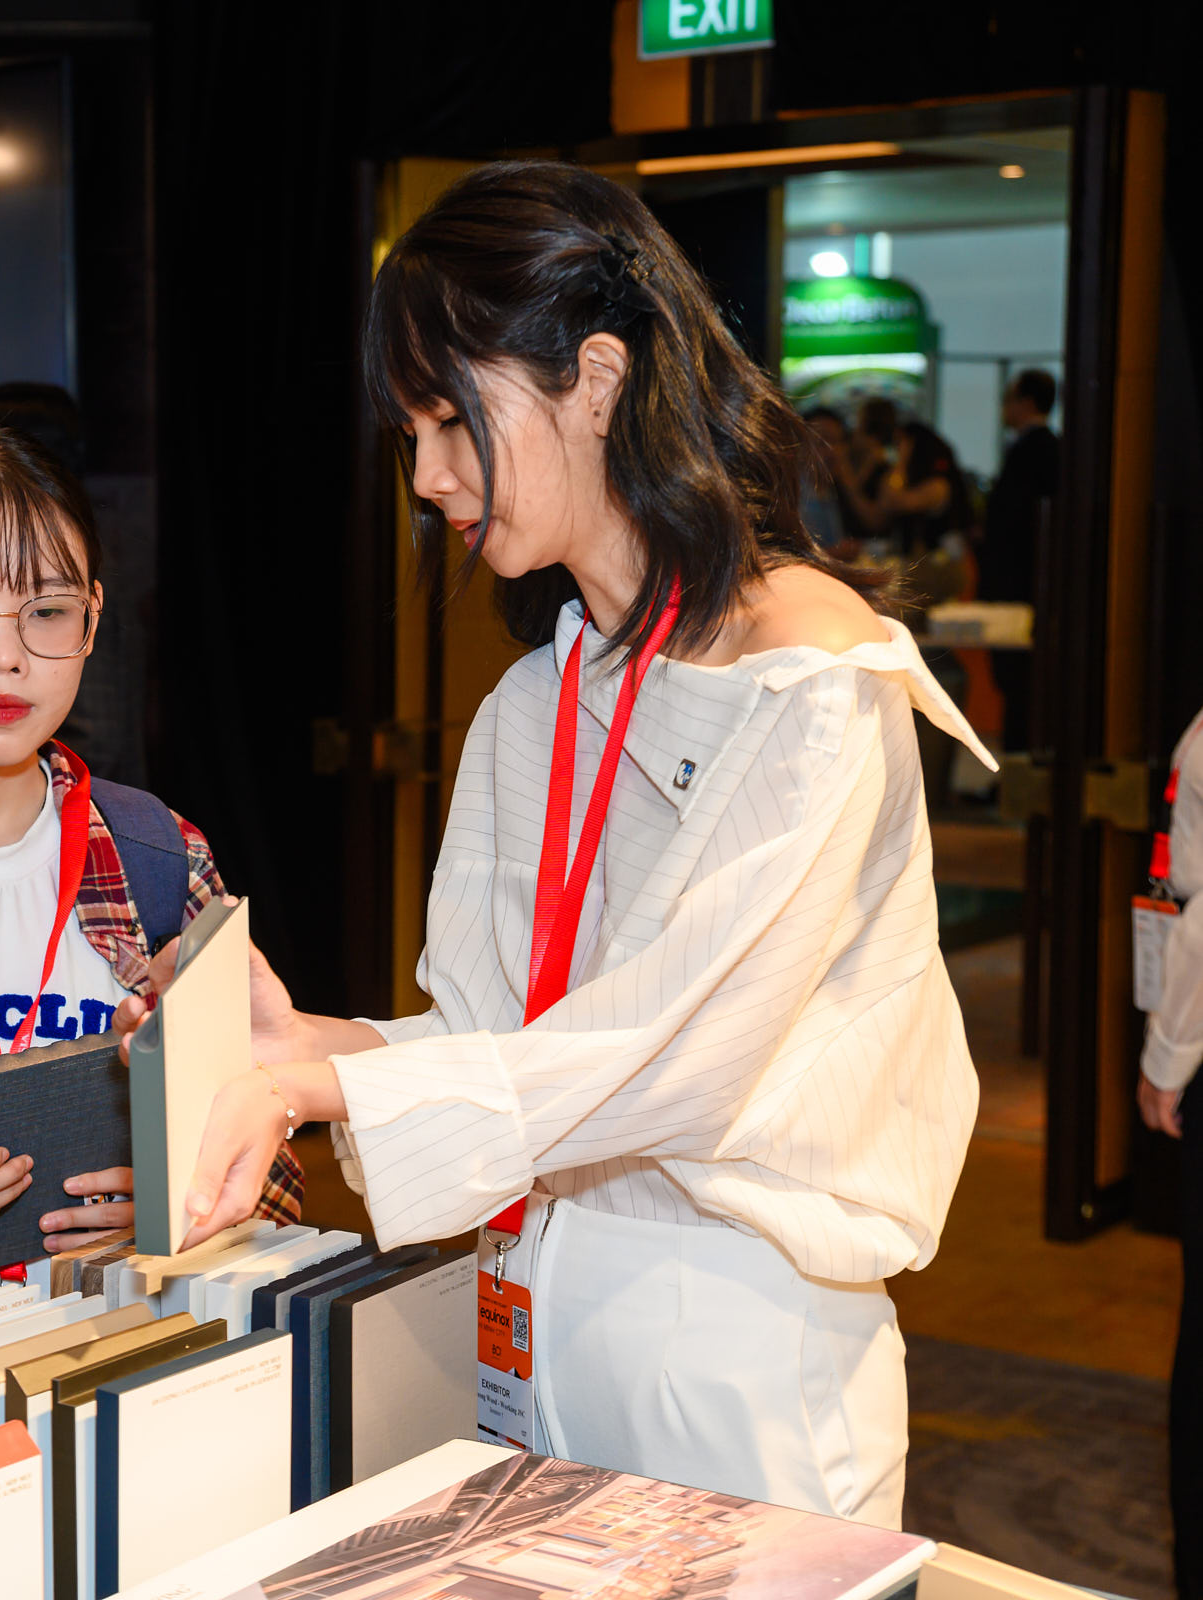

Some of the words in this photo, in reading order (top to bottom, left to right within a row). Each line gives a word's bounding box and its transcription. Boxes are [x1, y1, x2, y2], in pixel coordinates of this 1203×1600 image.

[669, 0, 756, 39] EXIT
[480, 1306, 510, 1329] equinox
[481, 1378, 511, 1399] EXHIBITOR
